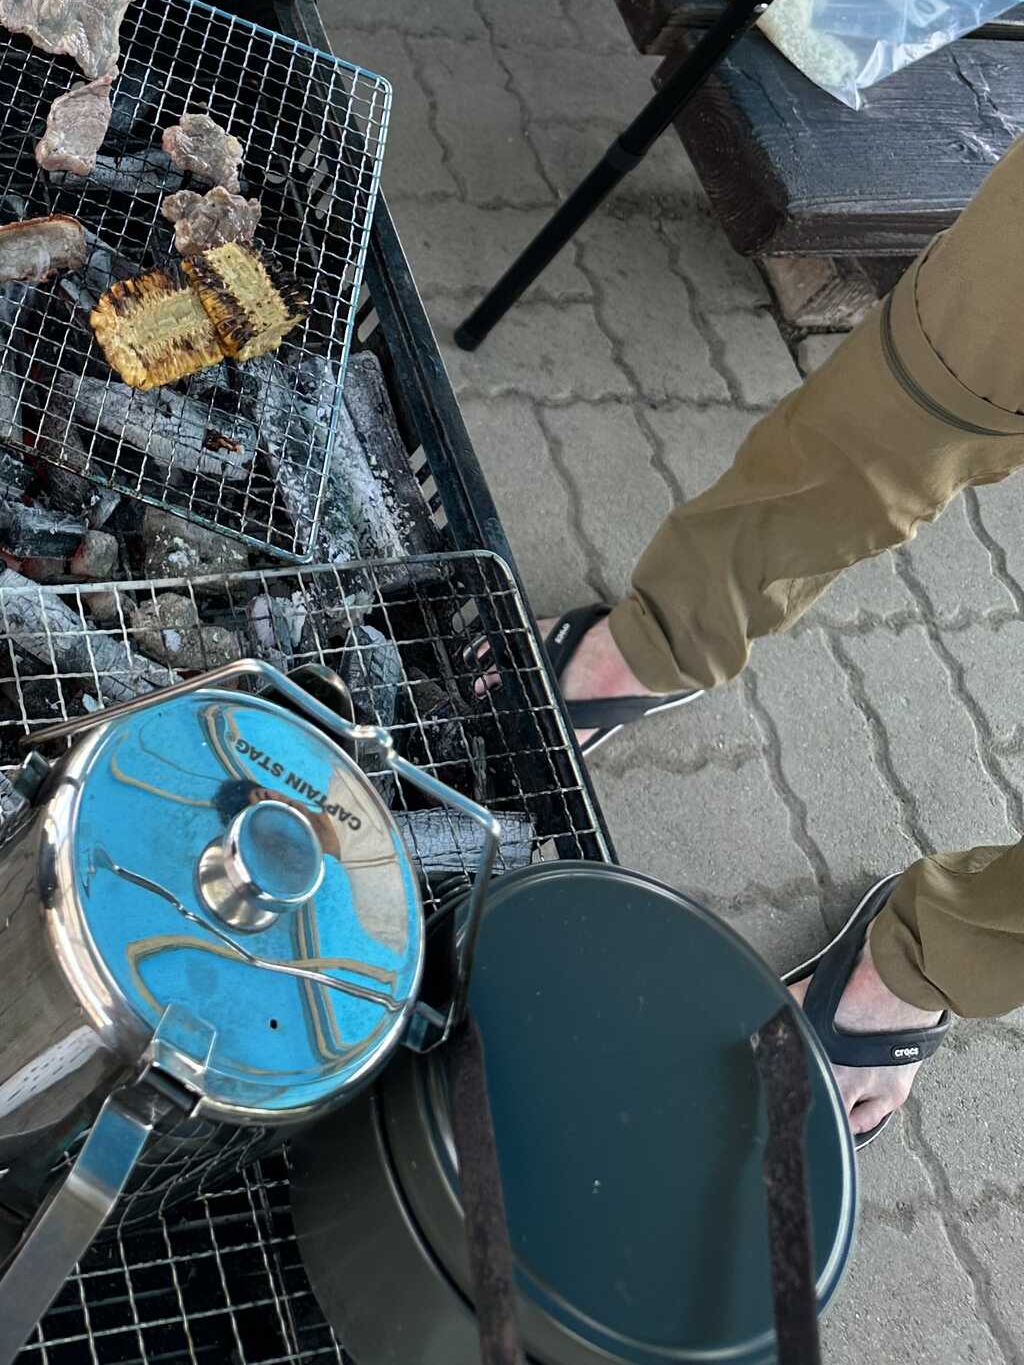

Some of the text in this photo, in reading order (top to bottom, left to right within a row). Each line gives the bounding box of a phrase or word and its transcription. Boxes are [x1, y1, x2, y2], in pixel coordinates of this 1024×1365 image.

[235, 739, 362, 831] CAPTAIN STAG
[894, 1048, 919, 1058] crocs
